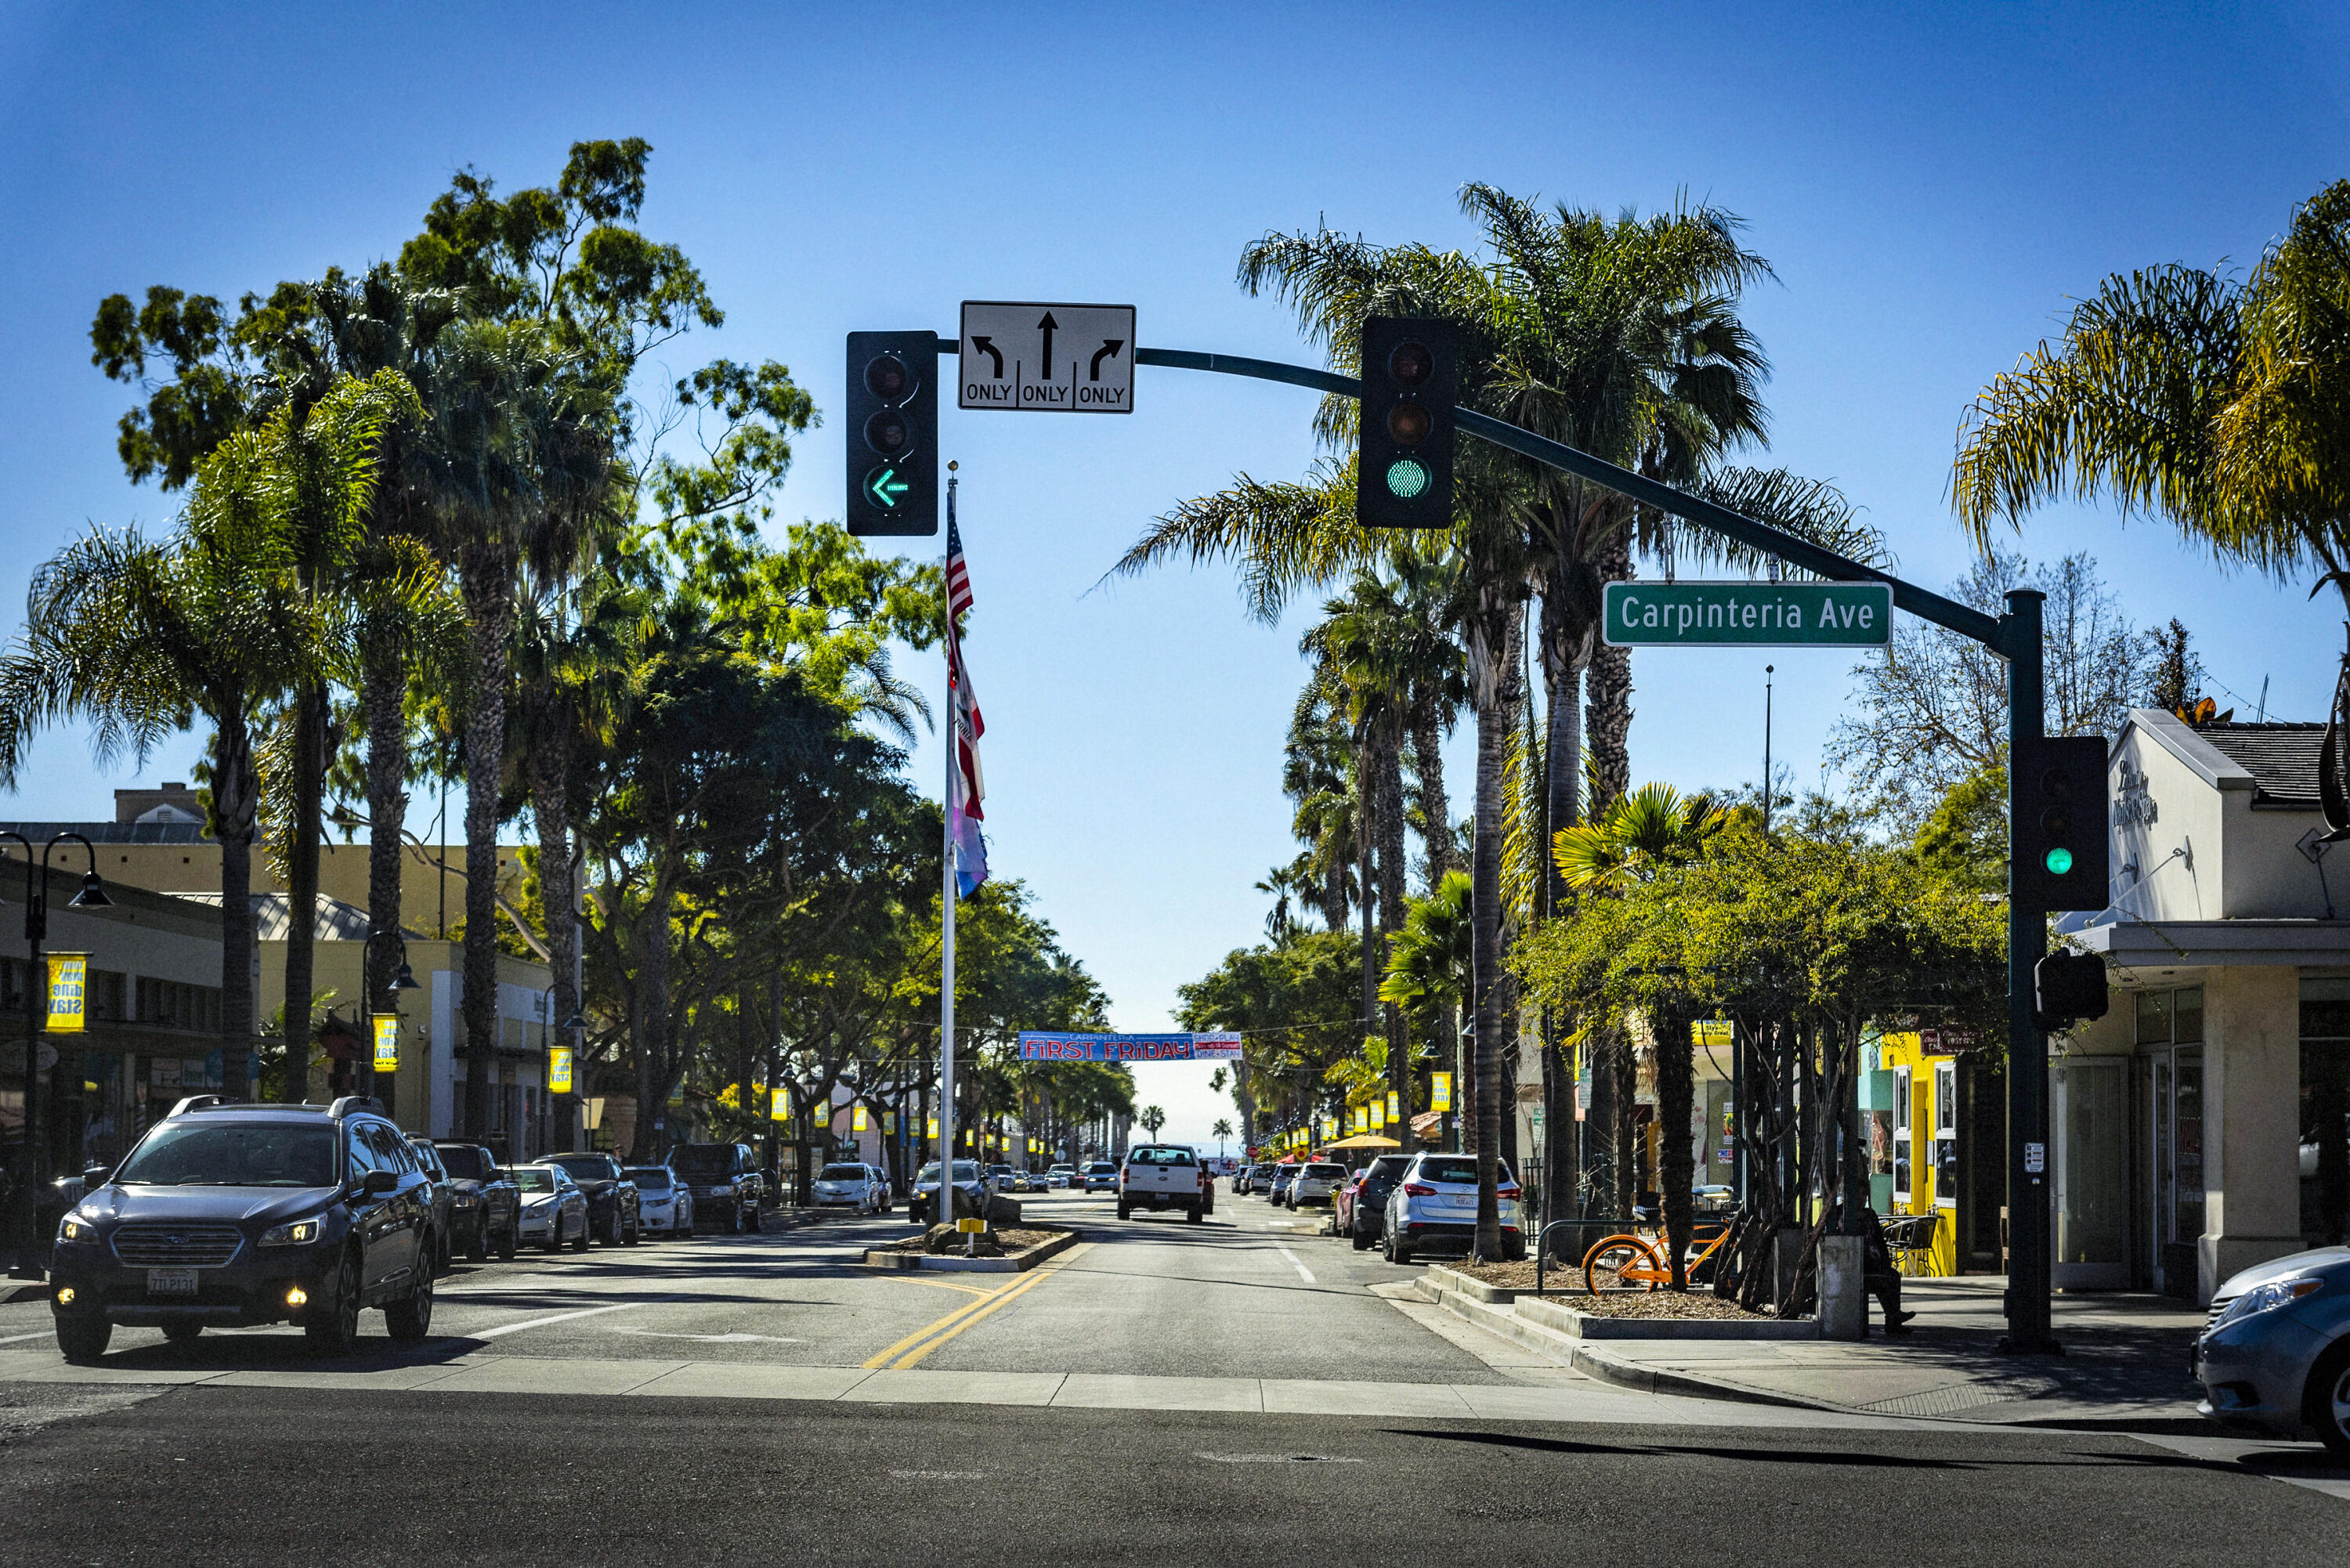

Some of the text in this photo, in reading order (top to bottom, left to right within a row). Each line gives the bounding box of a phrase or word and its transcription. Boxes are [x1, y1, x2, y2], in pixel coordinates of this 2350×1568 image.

[967, 384, 1125, 403] ONLY ONLY ONLY
[1622, 596, 1874, 636] Carpinteria Ave
[2113, 796, 2131, 826] Nails
